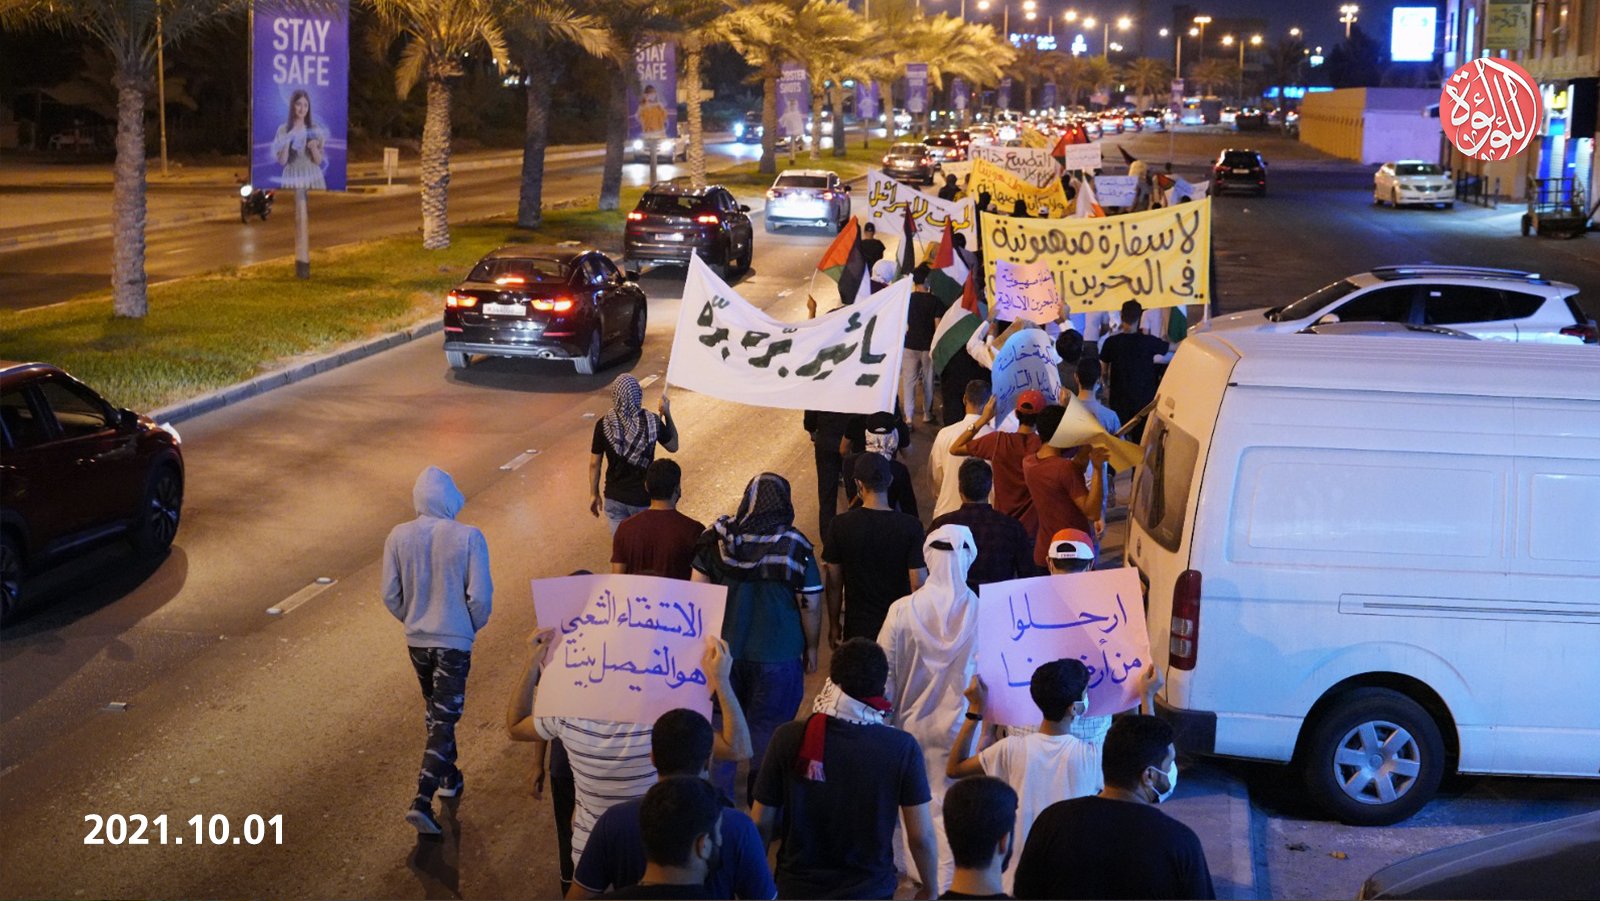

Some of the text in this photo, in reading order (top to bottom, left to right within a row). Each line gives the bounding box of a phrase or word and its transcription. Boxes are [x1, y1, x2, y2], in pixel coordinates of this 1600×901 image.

[273, 17, 331, 52] STAY
[635, 42, 667, 63] STAY
[273, 54, 330, 86] SAFE
[636, 62, 667, 81] SAFE
[777, 69, 806, 81] OOSTER
[991, 209, 1200, 269] لا سفارة صهيونية
[1069, 258, 1165, 305] البحرين
[1170, 258, 1205, 299] في
[561, 589, 703, 639] الاستفتاء الشعبي
[1009, 592, 1128, 641] ارحلوا
[565, 638, 707, 692] هو الفيصل بيننا
[1110, 652, 1143, 684] من
